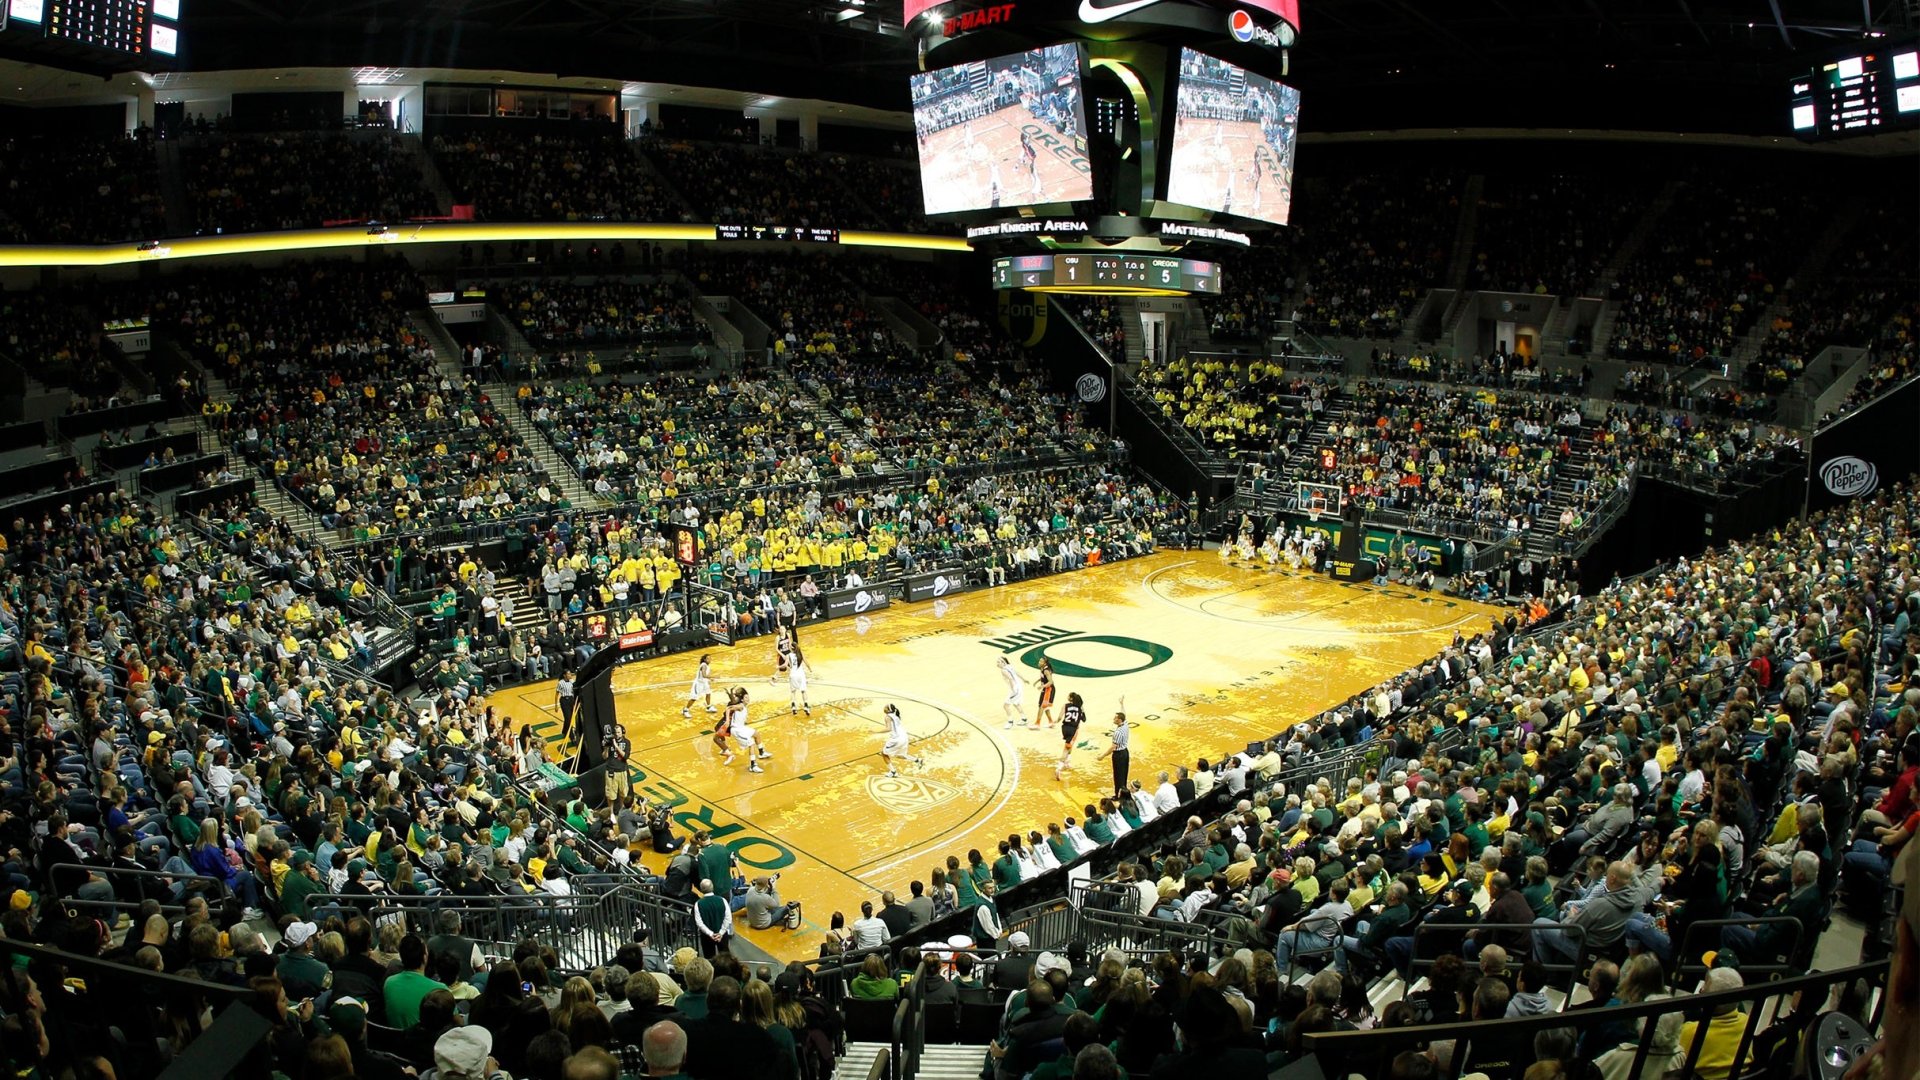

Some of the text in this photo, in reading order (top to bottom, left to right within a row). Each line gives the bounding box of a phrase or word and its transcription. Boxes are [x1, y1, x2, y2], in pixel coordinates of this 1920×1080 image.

[1000, 222, 1042, 234] KNIGHT
[1043, 219, 1089, 232] ARENA
[1161, 222, 1216, 238] MATTHEW
[1152, 259, 1179, 268] OREGON
[1000, 269, 1006, 283] 5
[1068, 266, 1075, 281] 1
[1161, 269, 1170, 283] 5
[1828, 464, 1868, 490] Pepper
[1842, 462, 1859, 477] Dr
[1064, 712, 1079, 723] 24
